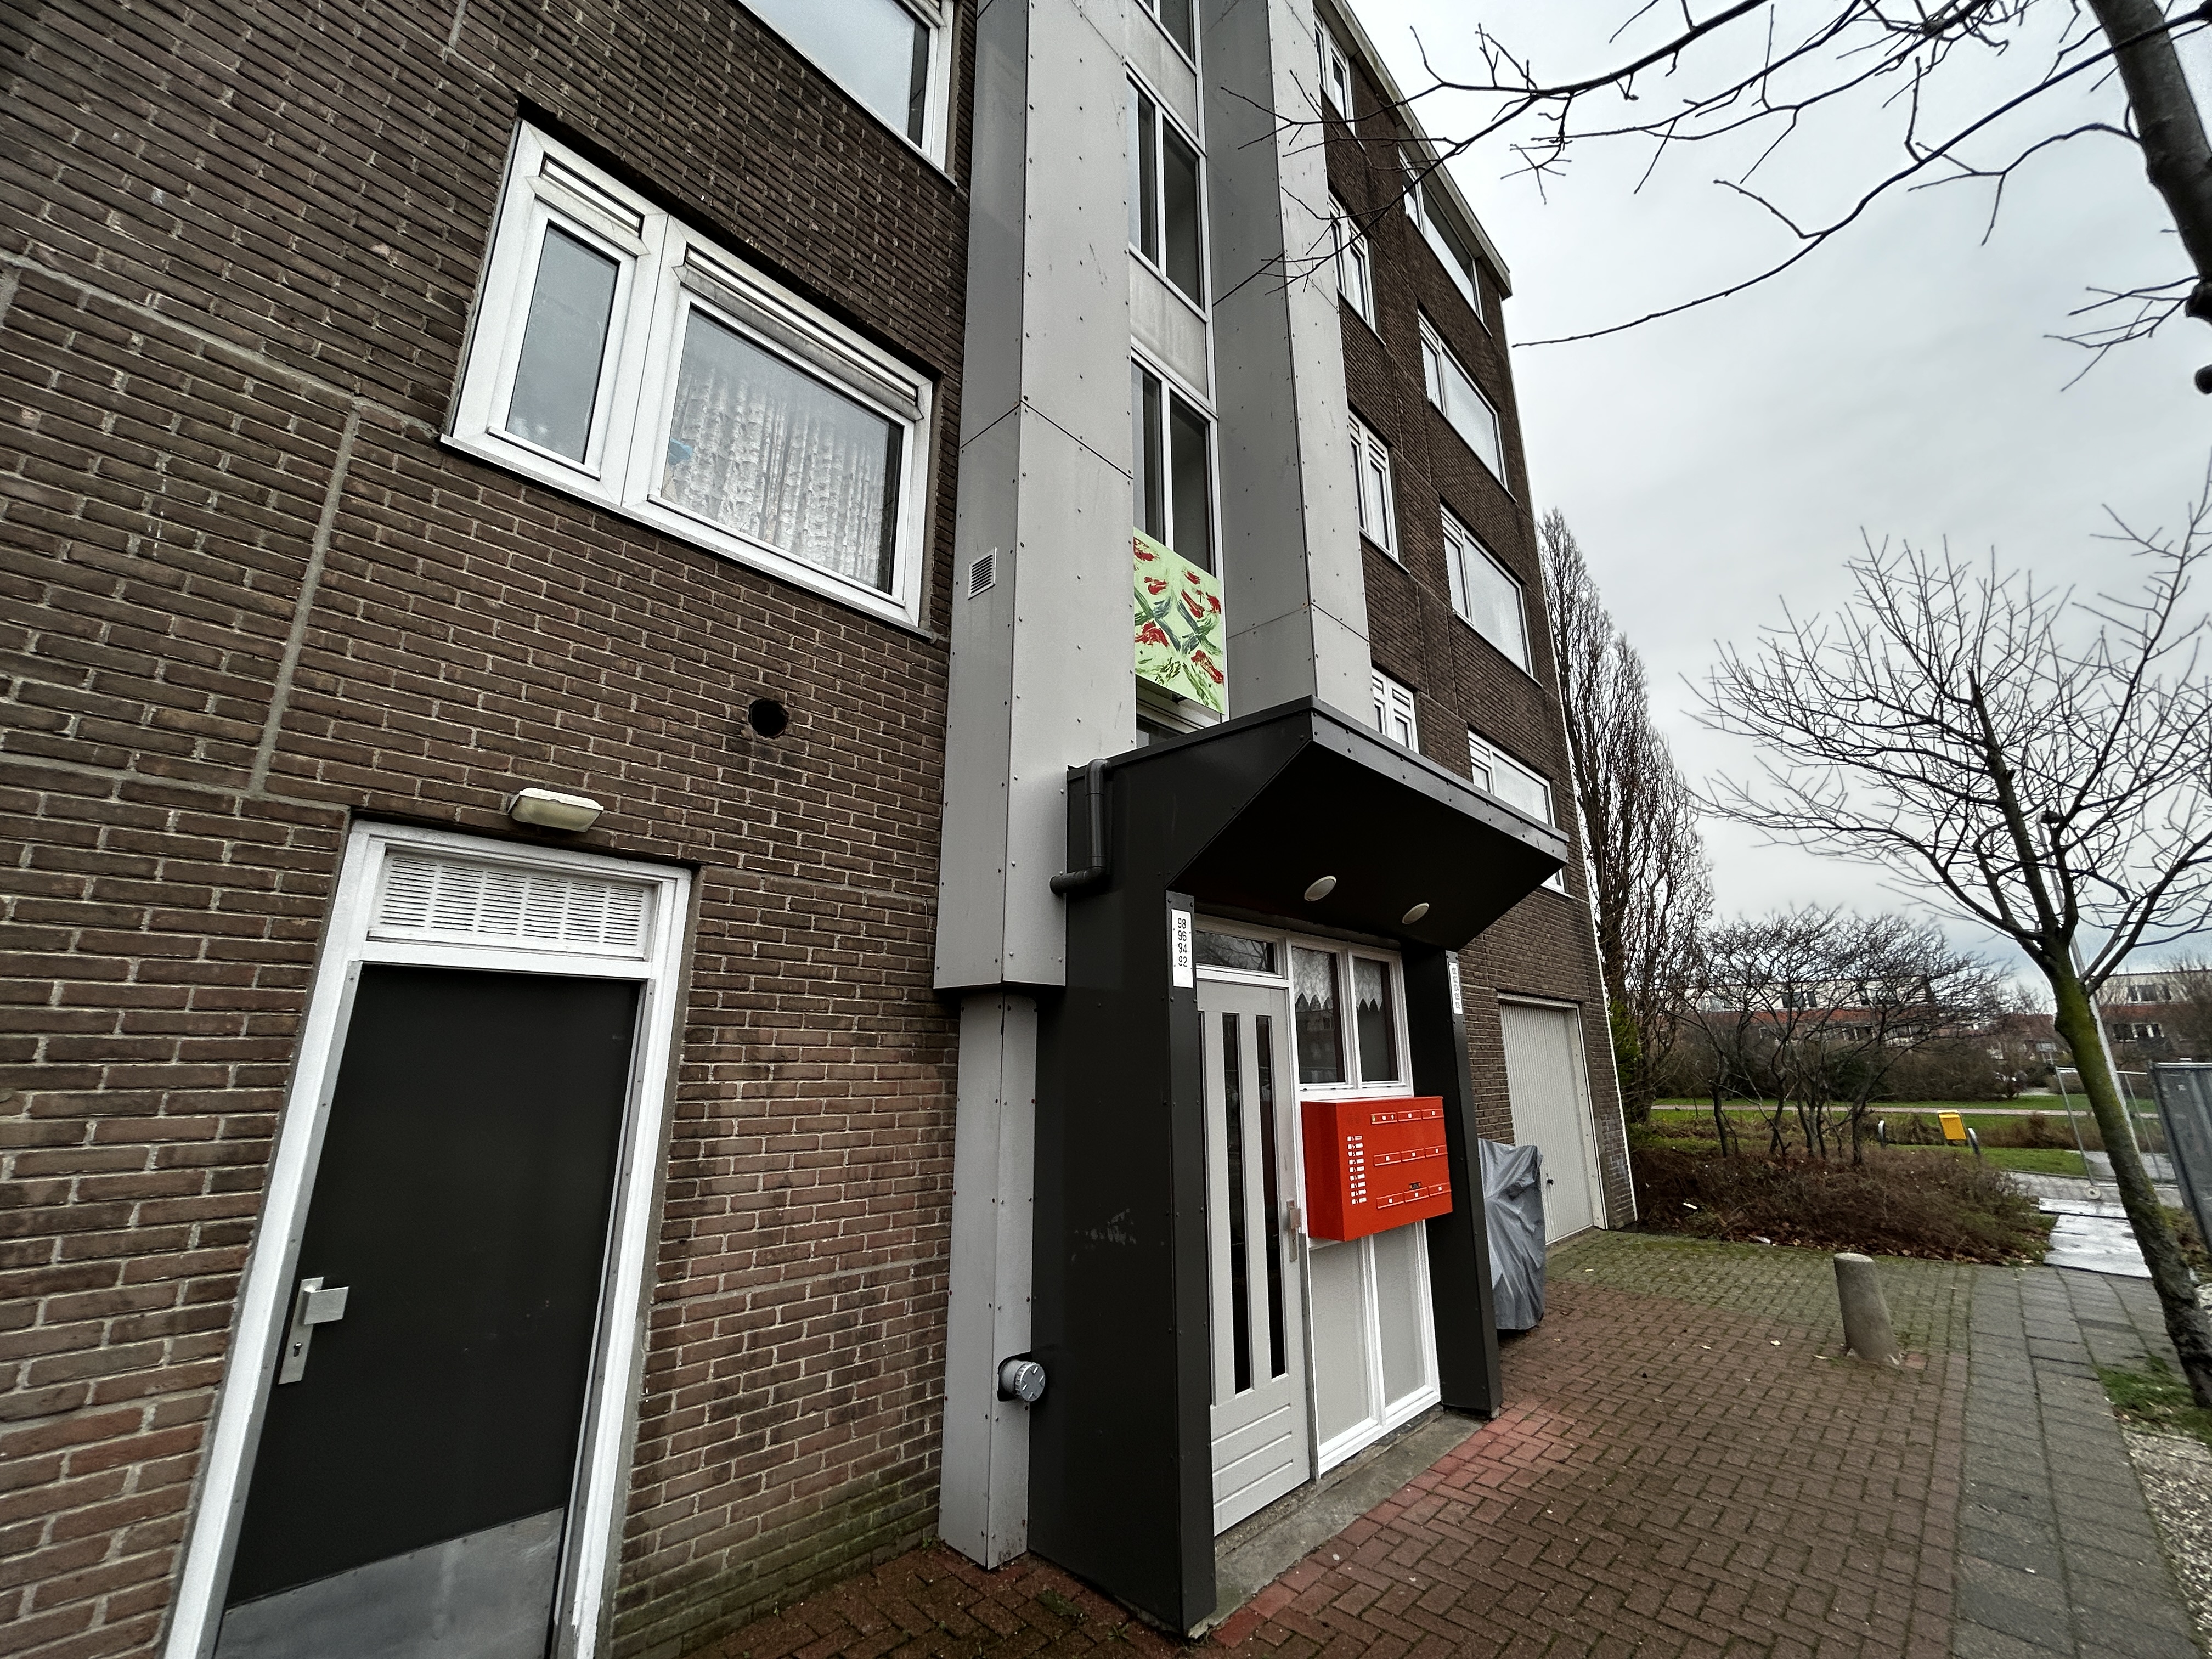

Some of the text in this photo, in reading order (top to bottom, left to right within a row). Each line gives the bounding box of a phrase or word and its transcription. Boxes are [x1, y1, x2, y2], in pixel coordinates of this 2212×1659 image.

[1177, 917, 1186, 929] 98
[1178, 930, 1187, 941] 96
[1178, 943, 1187, 954] 94
[1178, 955, 1188, 967] 92
